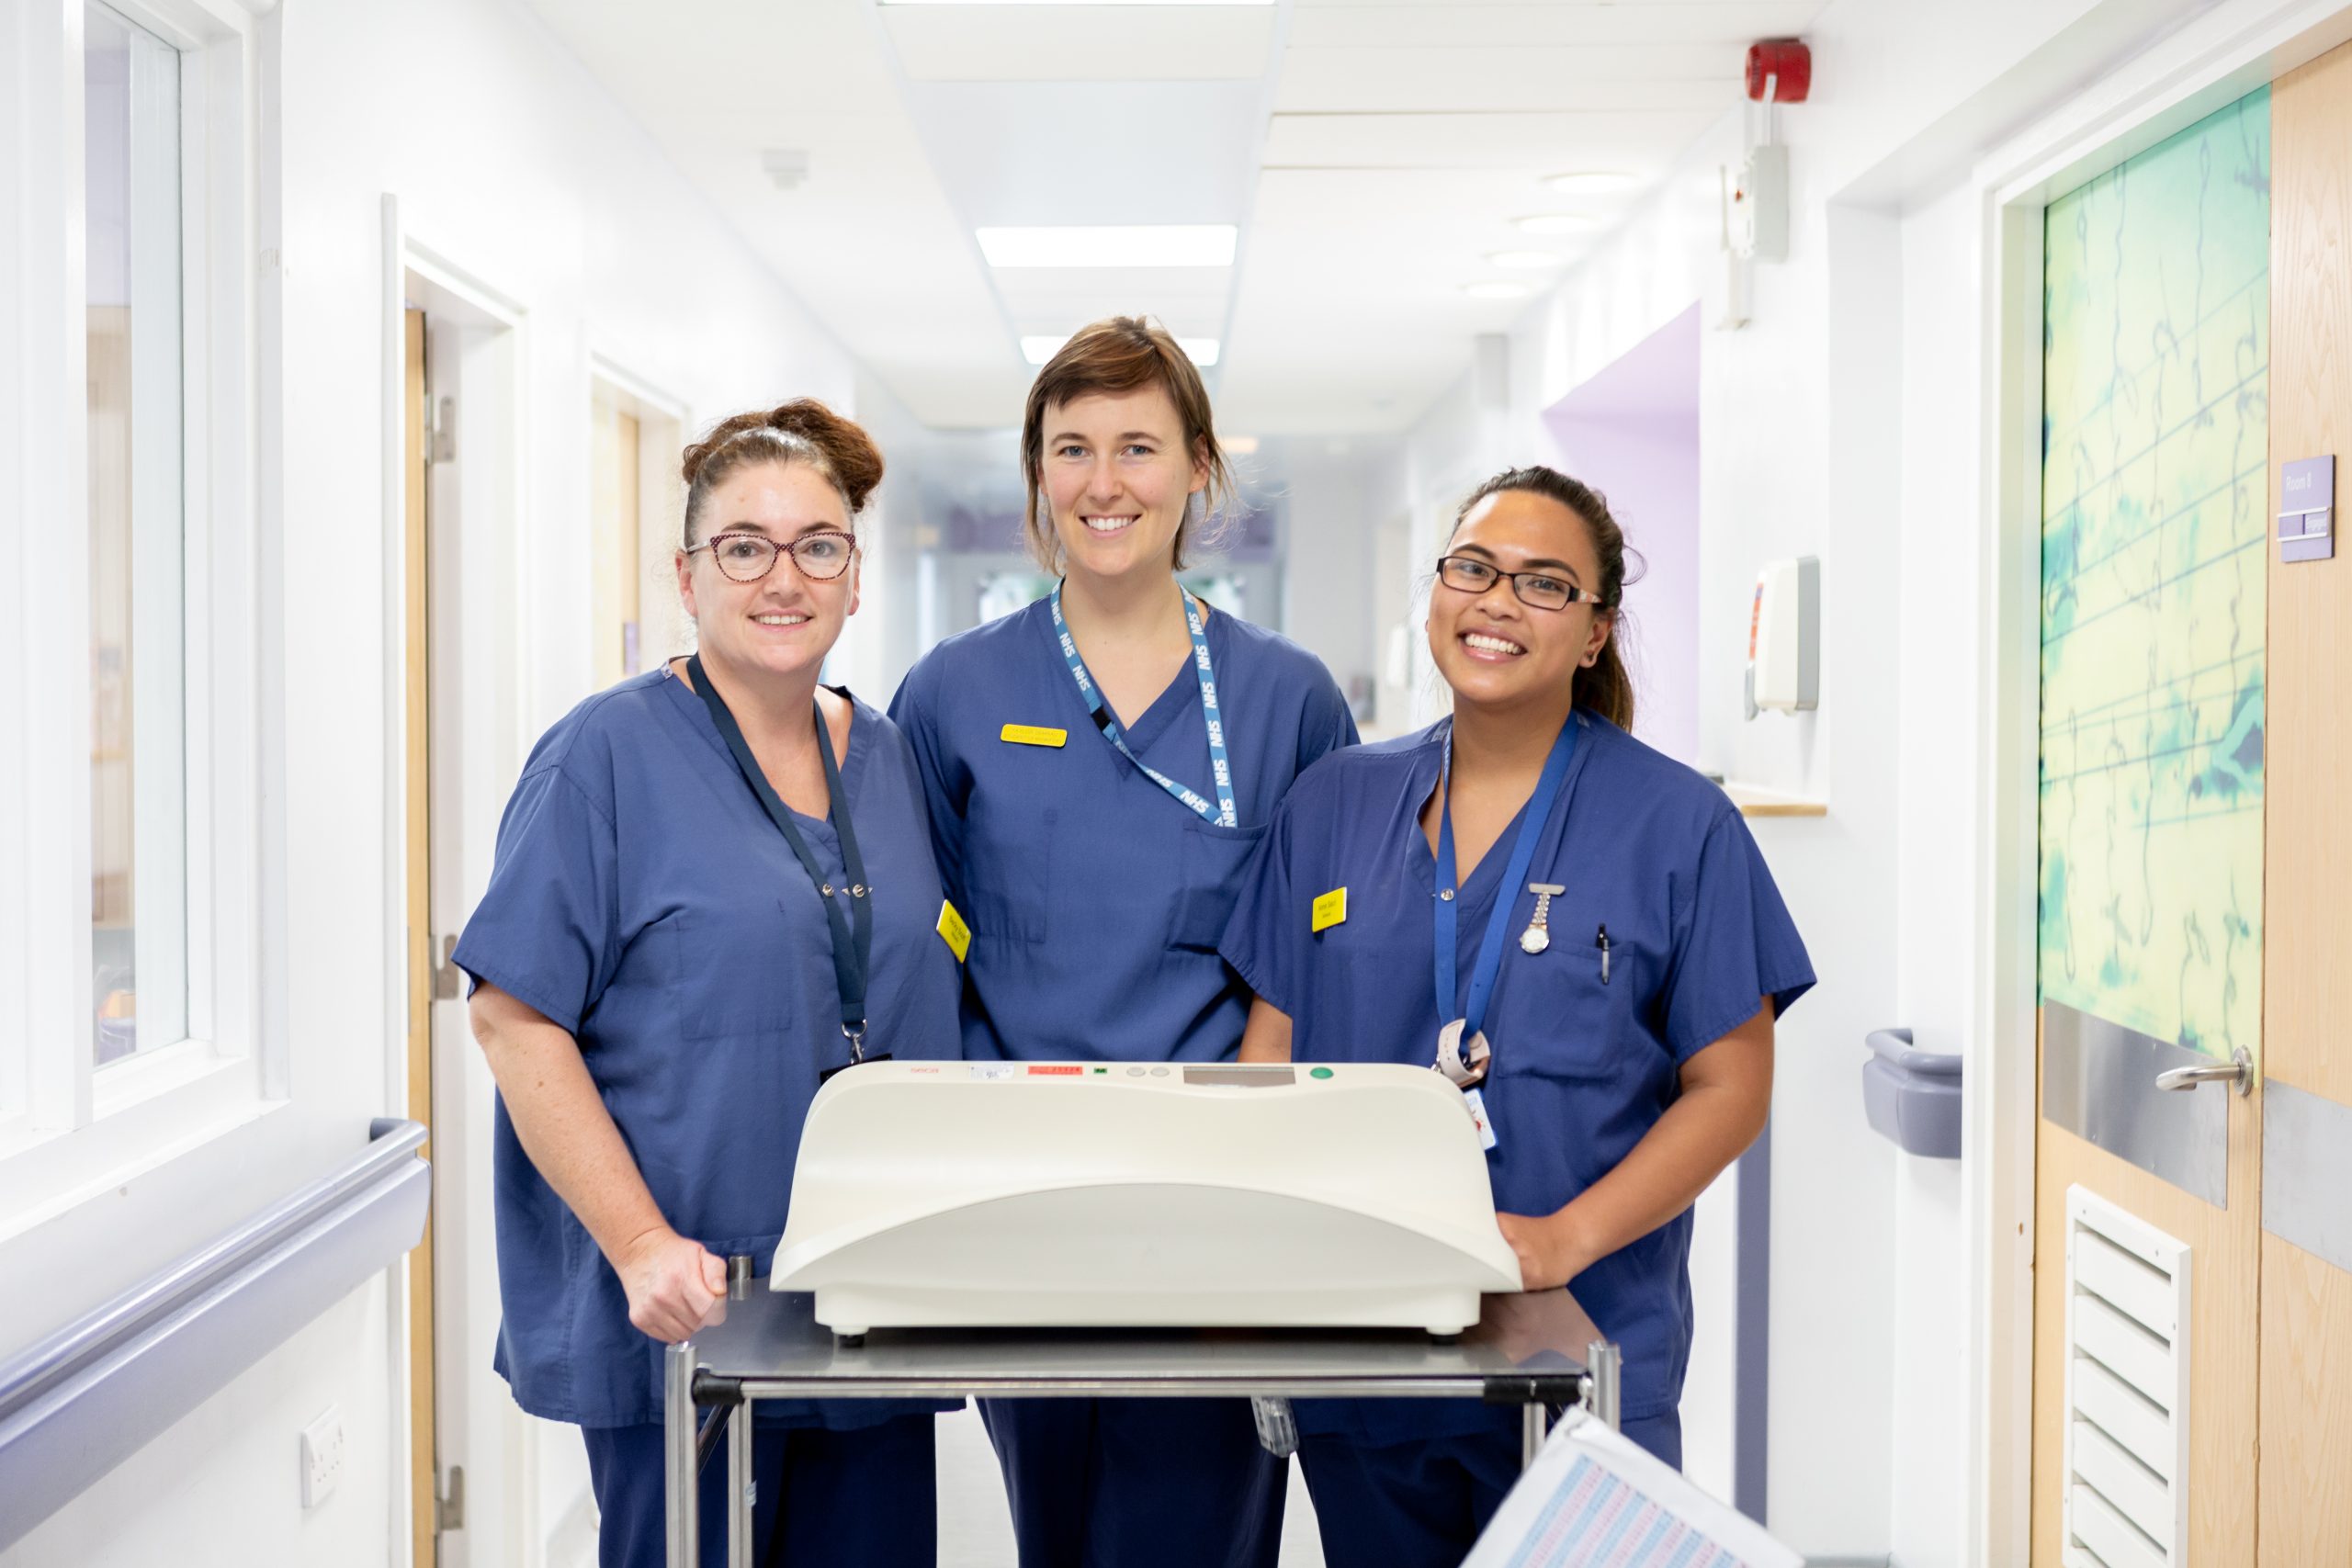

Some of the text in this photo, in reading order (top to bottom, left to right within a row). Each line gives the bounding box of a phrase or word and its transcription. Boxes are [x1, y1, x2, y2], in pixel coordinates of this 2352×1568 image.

[2286, 475, 2306, 492] Room
[1051, 601, 1062, 626] NHS
[1059, 632, 1075, 658] NHS
[1072, 664, 1091, 692] NHS
[1188, 612, 1236, 827] NHS NHS NHS NHS NHS NHS
[1146, 769, 1173, 788] NHS
[1179, 789, 1209, 814] NHS
